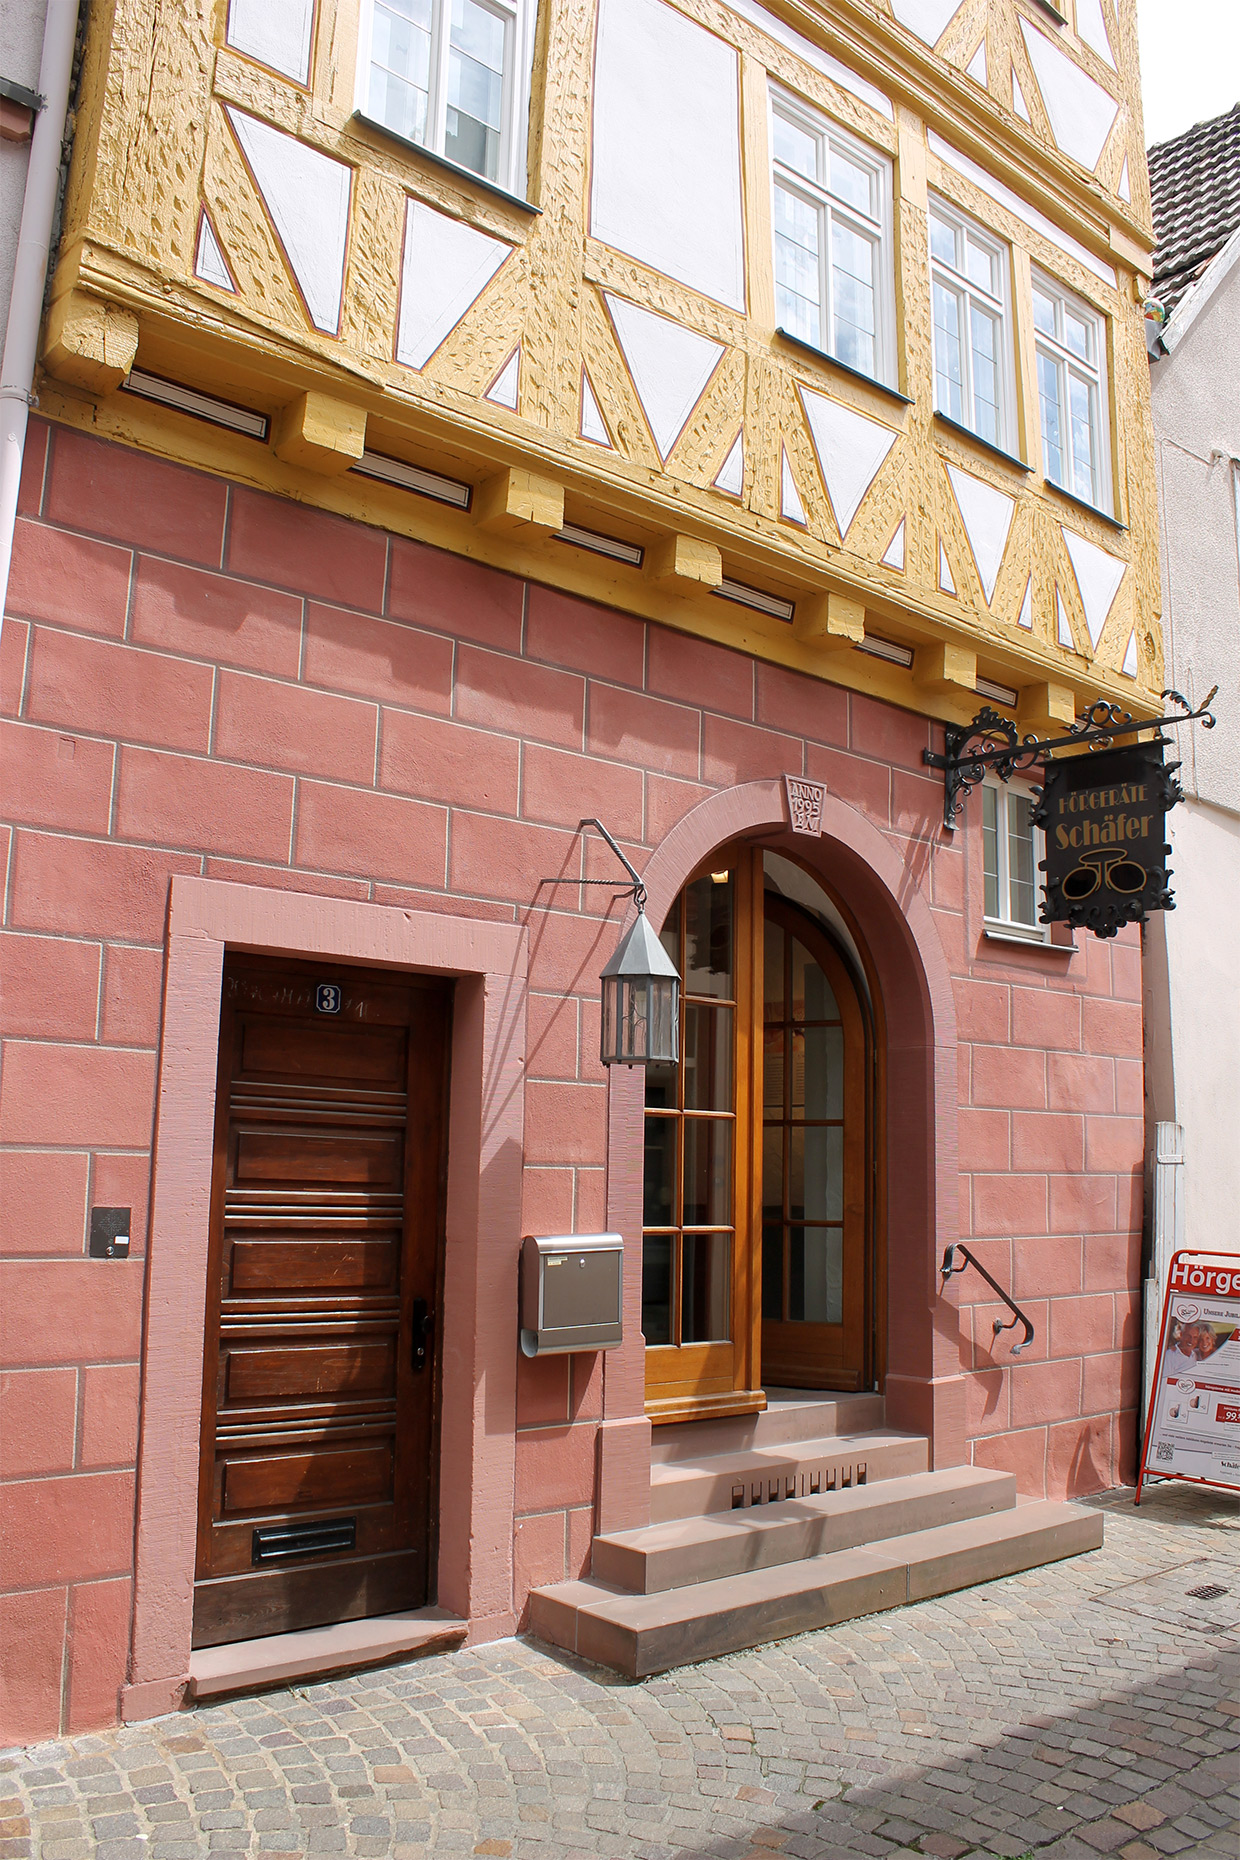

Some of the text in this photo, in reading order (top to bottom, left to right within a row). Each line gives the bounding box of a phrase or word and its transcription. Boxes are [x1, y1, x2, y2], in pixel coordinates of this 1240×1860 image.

[790, 782, 821, 802] ANNO
[1058, 783, 1149, 814] HÖRGERÄTE
[792, 798, 820, 816] 1995
[1055, 813, 1154, 849] Schäfer
[322, 987, 335, 1010] 3
